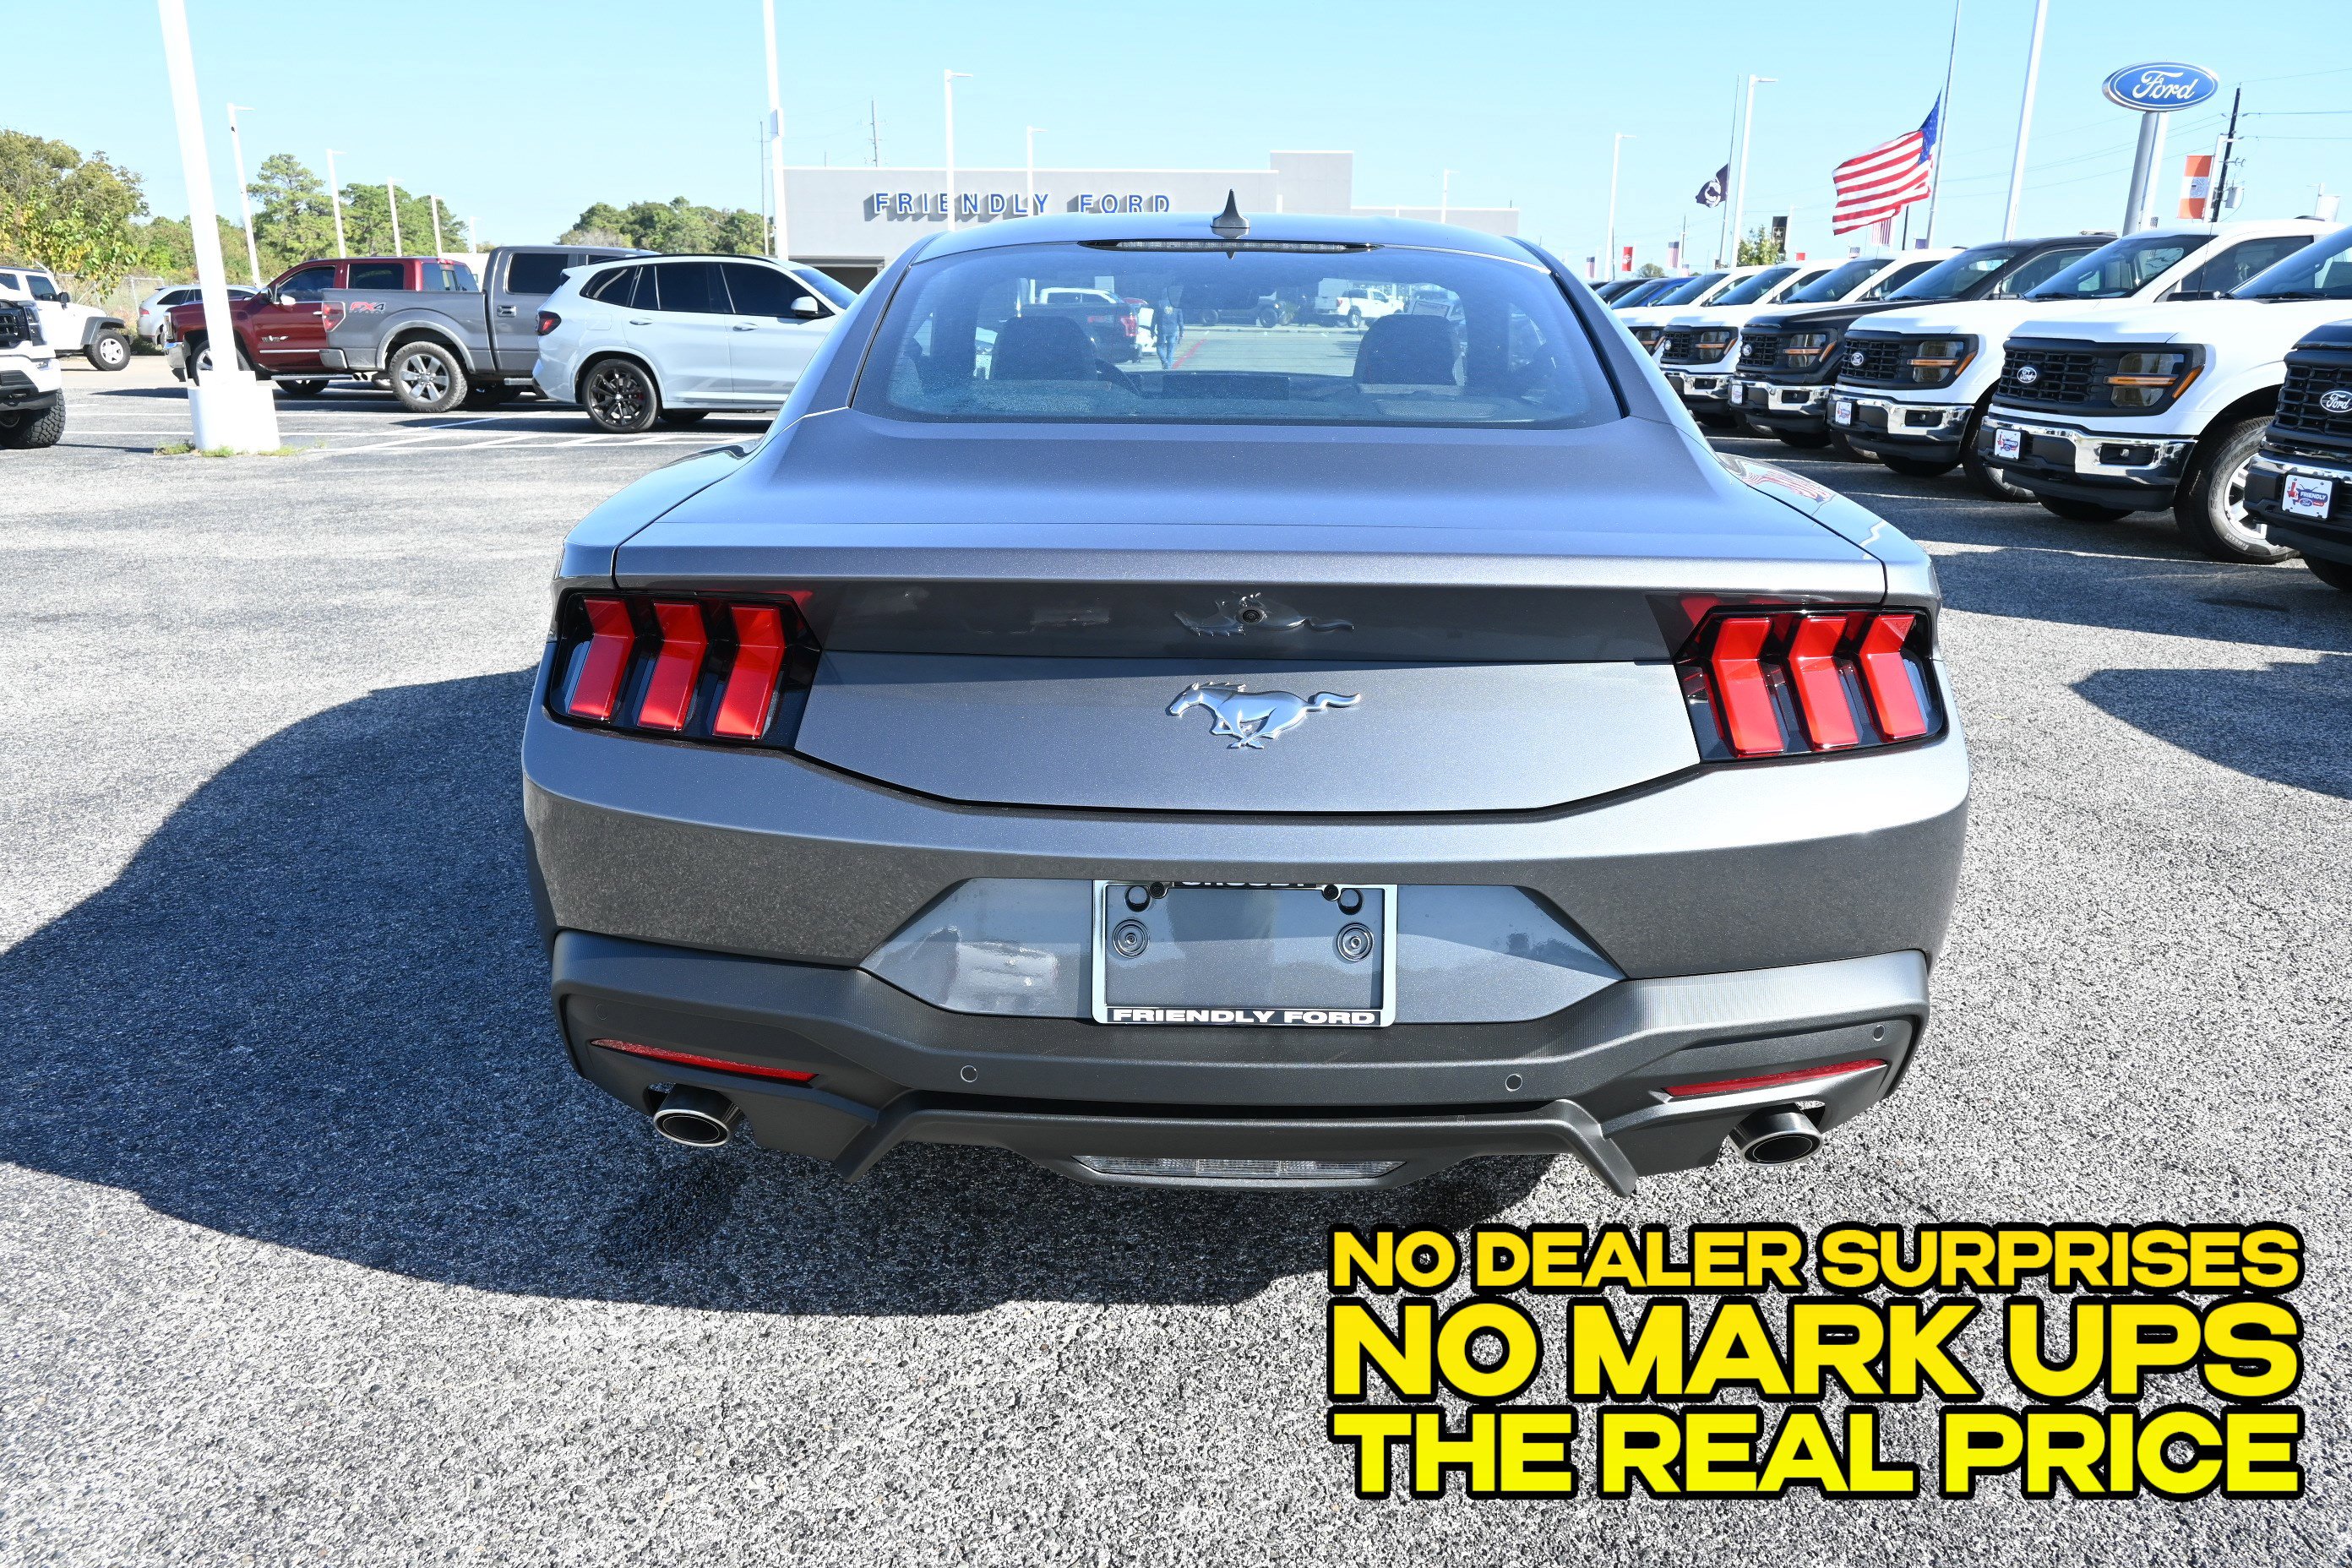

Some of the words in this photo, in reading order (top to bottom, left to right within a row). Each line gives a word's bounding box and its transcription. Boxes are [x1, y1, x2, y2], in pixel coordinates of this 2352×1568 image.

[2132, 70, 2200, 99] Ford
[874, 192, 1050, 215] FRIENDLY
[1079, 193, 1171, 213] FORD
[349, 302, 386, 312] FX4
[2326, 393, 2352, 410] Ford
[2300, 492, 2328, 501] FRIENDLY
[1112, 1009, 1276, 1024] FRIENDLY
[1283, 1011, 1375, 1025] FORD
